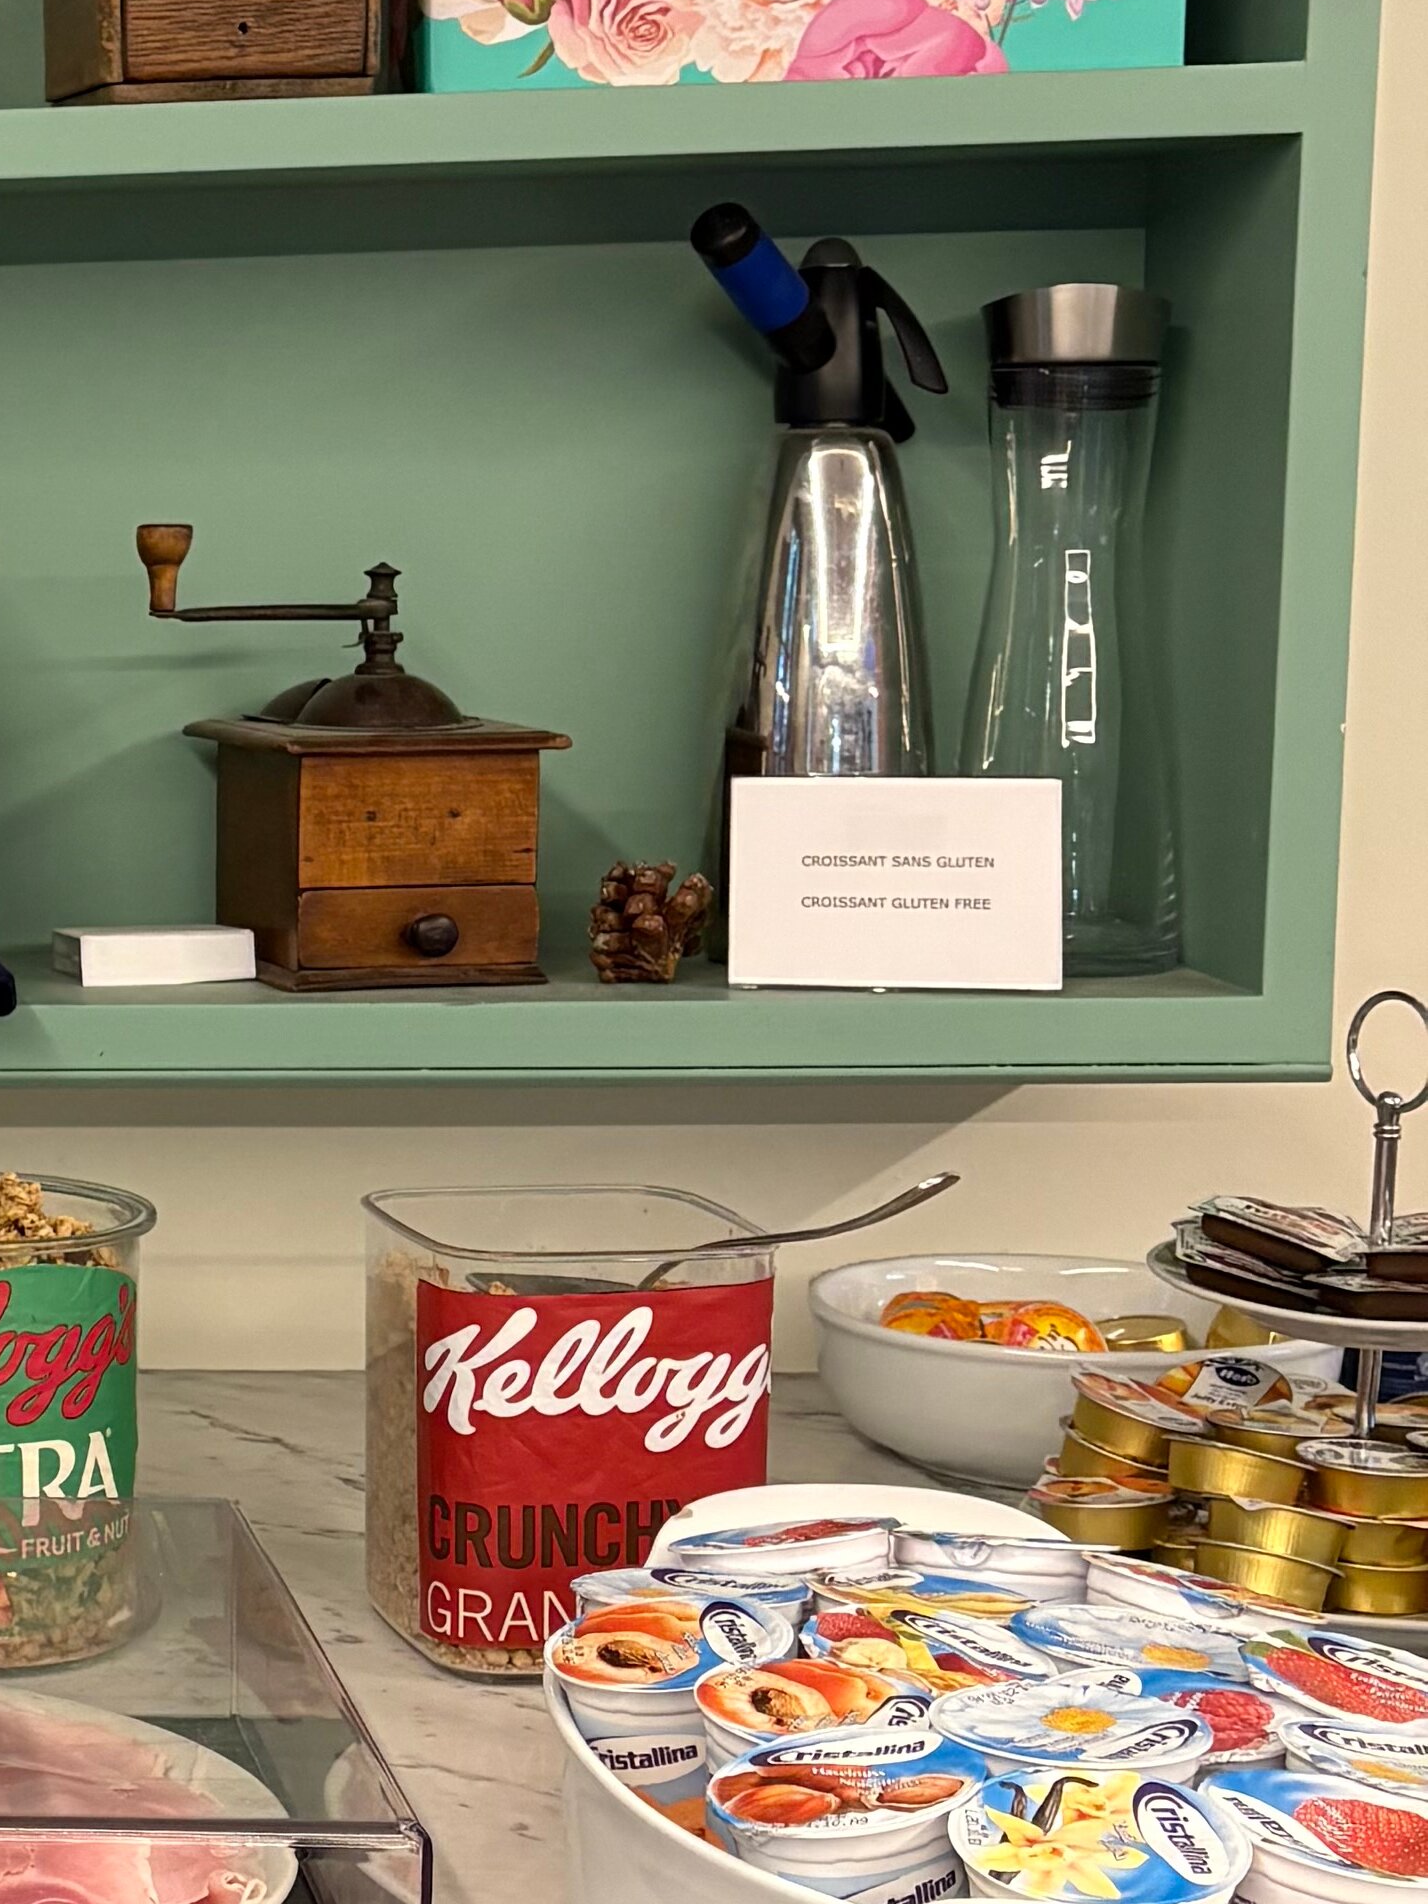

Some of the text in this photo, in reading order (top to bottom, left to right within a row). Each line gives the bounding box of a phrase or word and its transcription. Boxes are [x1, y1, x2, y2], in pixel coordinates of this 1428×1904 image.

[801, 855, 995, 869] CROISSANT SANS GLUTEN
[801, 896, 992, 910] CROISSANT GLUTEN FREE
[423, 1306, 772, 1453] Kellogg
[20, 1529, 81, 1560] FRUIT
[86, 1527, 102, 1547] &
[907, 1614, 1034, 1668] Cristallina
[767, 1740, 926, 1764] Cristallina
[1144, 1793, 1214, 1875] Cristallina
